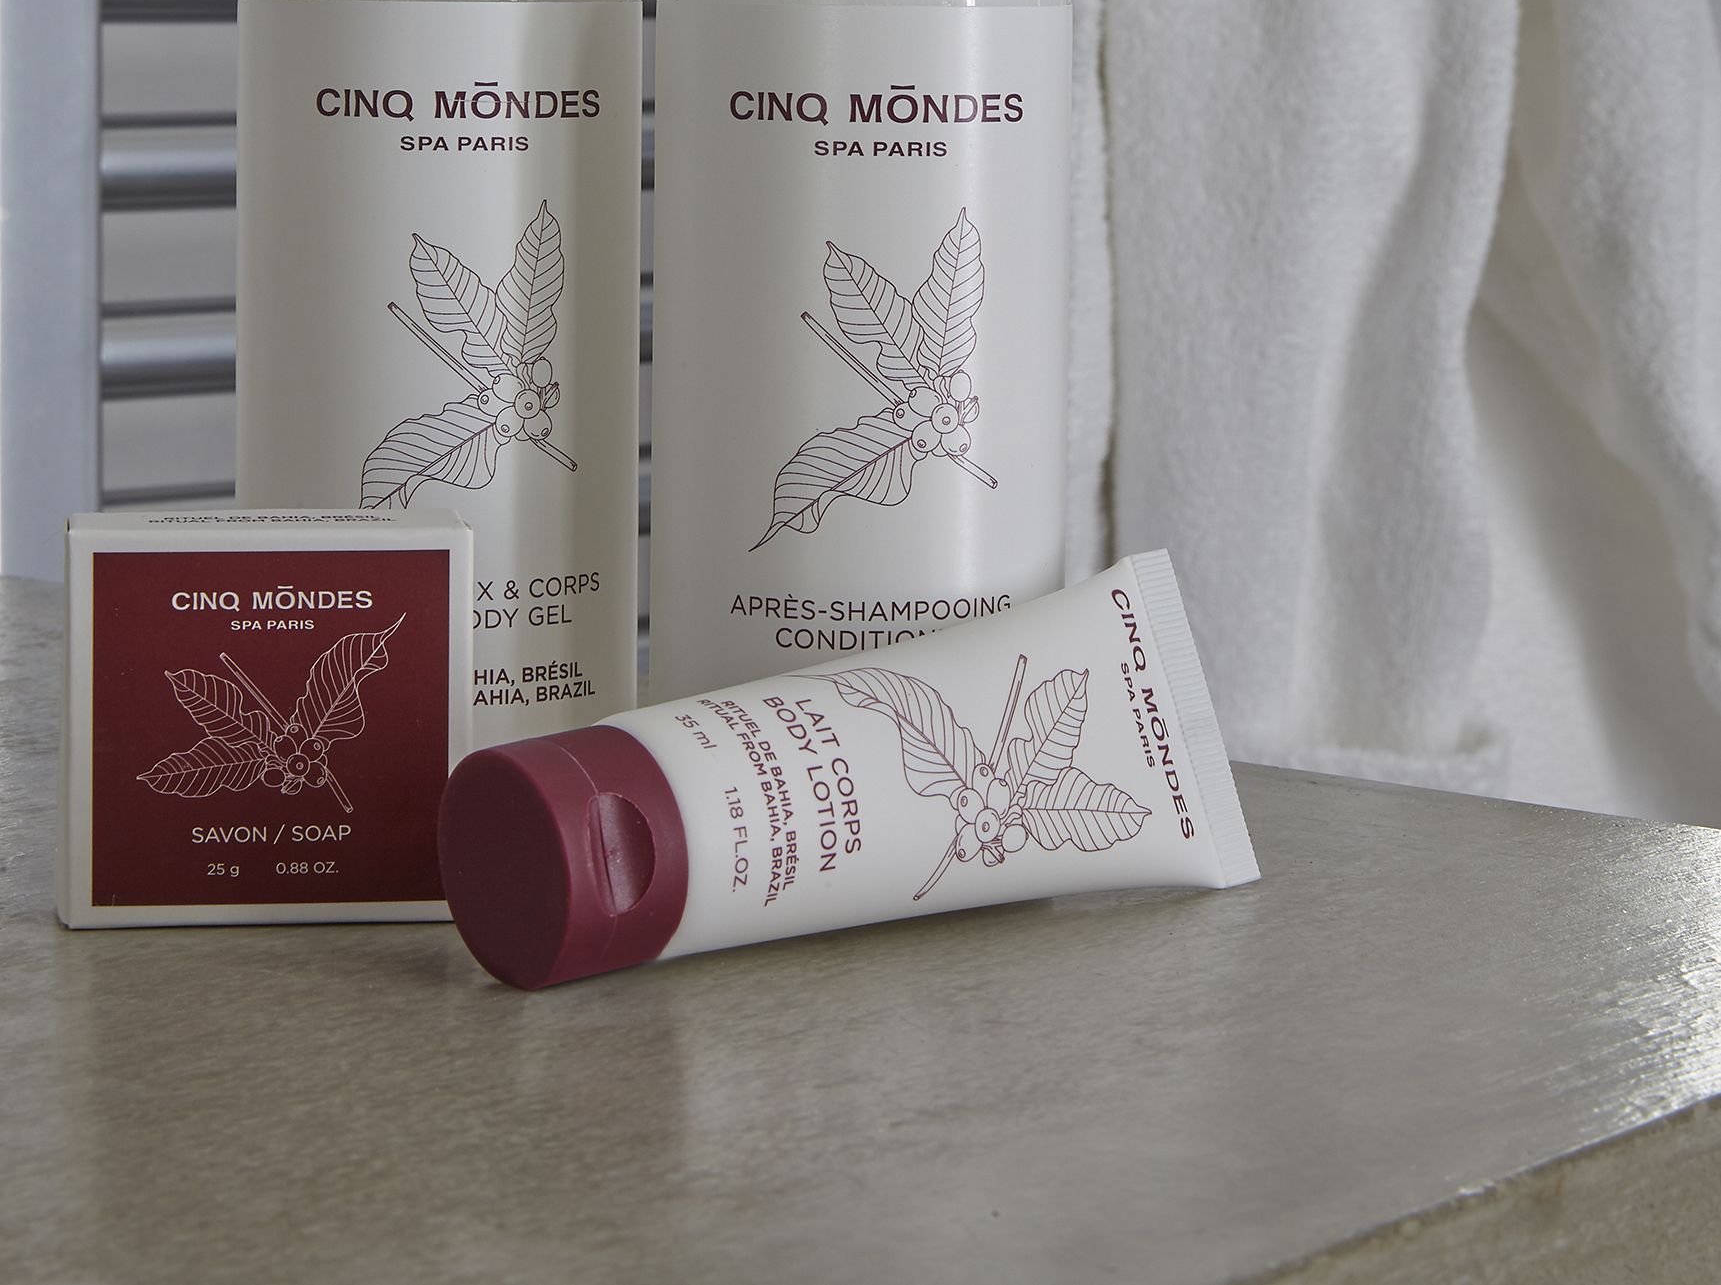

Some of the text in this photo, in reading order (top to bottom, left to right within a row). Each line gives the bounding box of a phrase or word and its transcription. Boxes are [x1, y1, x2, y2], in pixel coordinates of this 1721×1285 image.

[316, 88, 415, 122] CINQ
[729, 90, 829, 126] CINQ
[400, 135, 530, 152] SPA PARIS
[814, 140, 948, 157] SPA PARIS
[503, 580, 520, 600] &
[529, 572, 600, 598] CORPS
[171, 591, 240, 612] CINQ
[528, 604, 573, 627] GEL
[730, 593, 1011, 623] APRÈS-SHAMPOOING
[230, 619, 315, 631] SPA PARIS
[1111, 588, 1147, 672] CINQ
[474, 660, 583, 686] HIA, BRÉSIL
[473, 680, 596, 706] AHIA, BRAZIL
[1120, 662, 1156, 768] SPA PARIS
[675, 714, 718, 749] 35 ml
[762, 696, 837, 872] BODY LOTION
[795, 698, 862, 854] LAIT CORPS
[697, 698, 783, 907] RITUAL FROM BAHIA, BRAZIL
[720, 699, 800, 891] RITUEL DE BAHIA, BRÉSIL
[724, 786, 744, 819] 1.18
[191, 823, 352, 845] SAVON / SOAP
[207, 861, 340, 878] 25 g 0.88 OZ.
